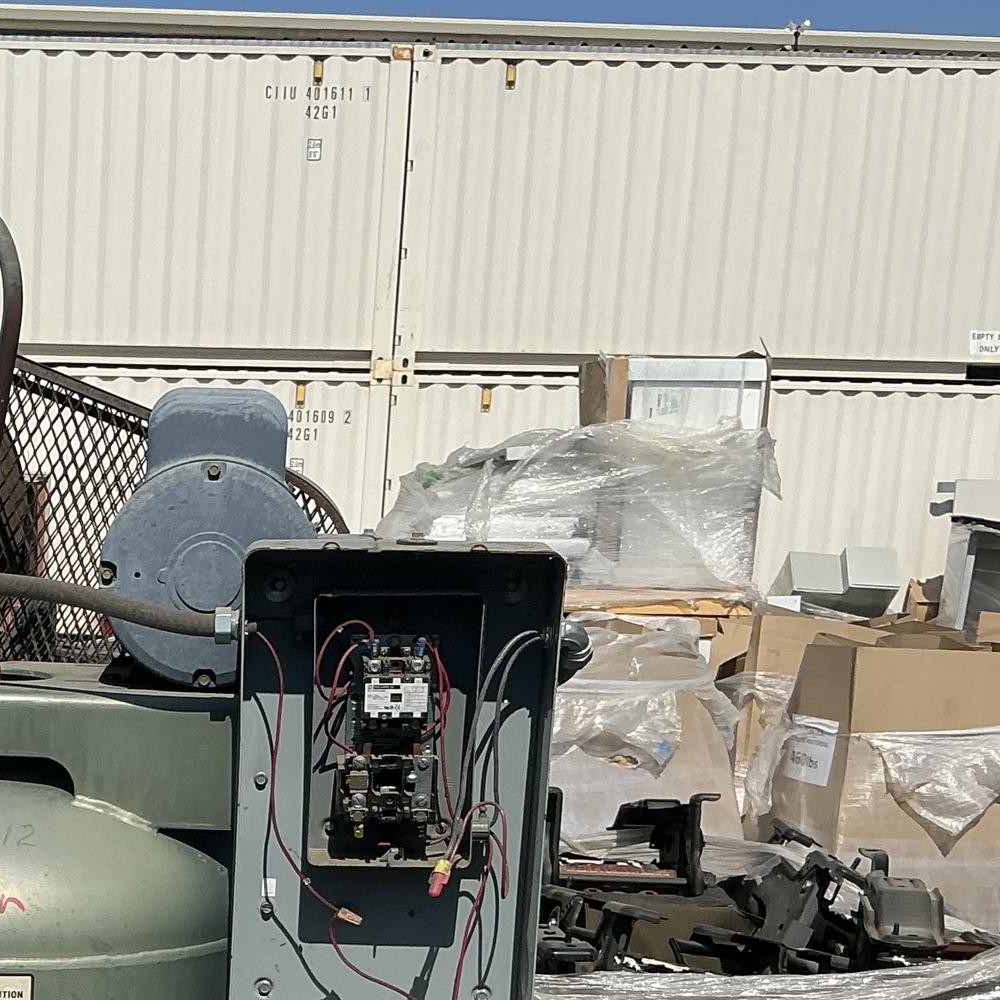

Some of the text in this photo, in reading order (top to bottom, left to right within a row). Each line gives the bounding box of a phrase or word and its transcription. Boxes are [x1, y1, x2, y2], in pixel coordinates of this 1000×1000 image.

[265, 85, 297, 100] CIIU
[306, 86, 353, 101] 401611
[305, 105, 336, 119] 42G1
[288, 409, 351, 424] 401609 2
[287, 427, 318, 441] 42G1
